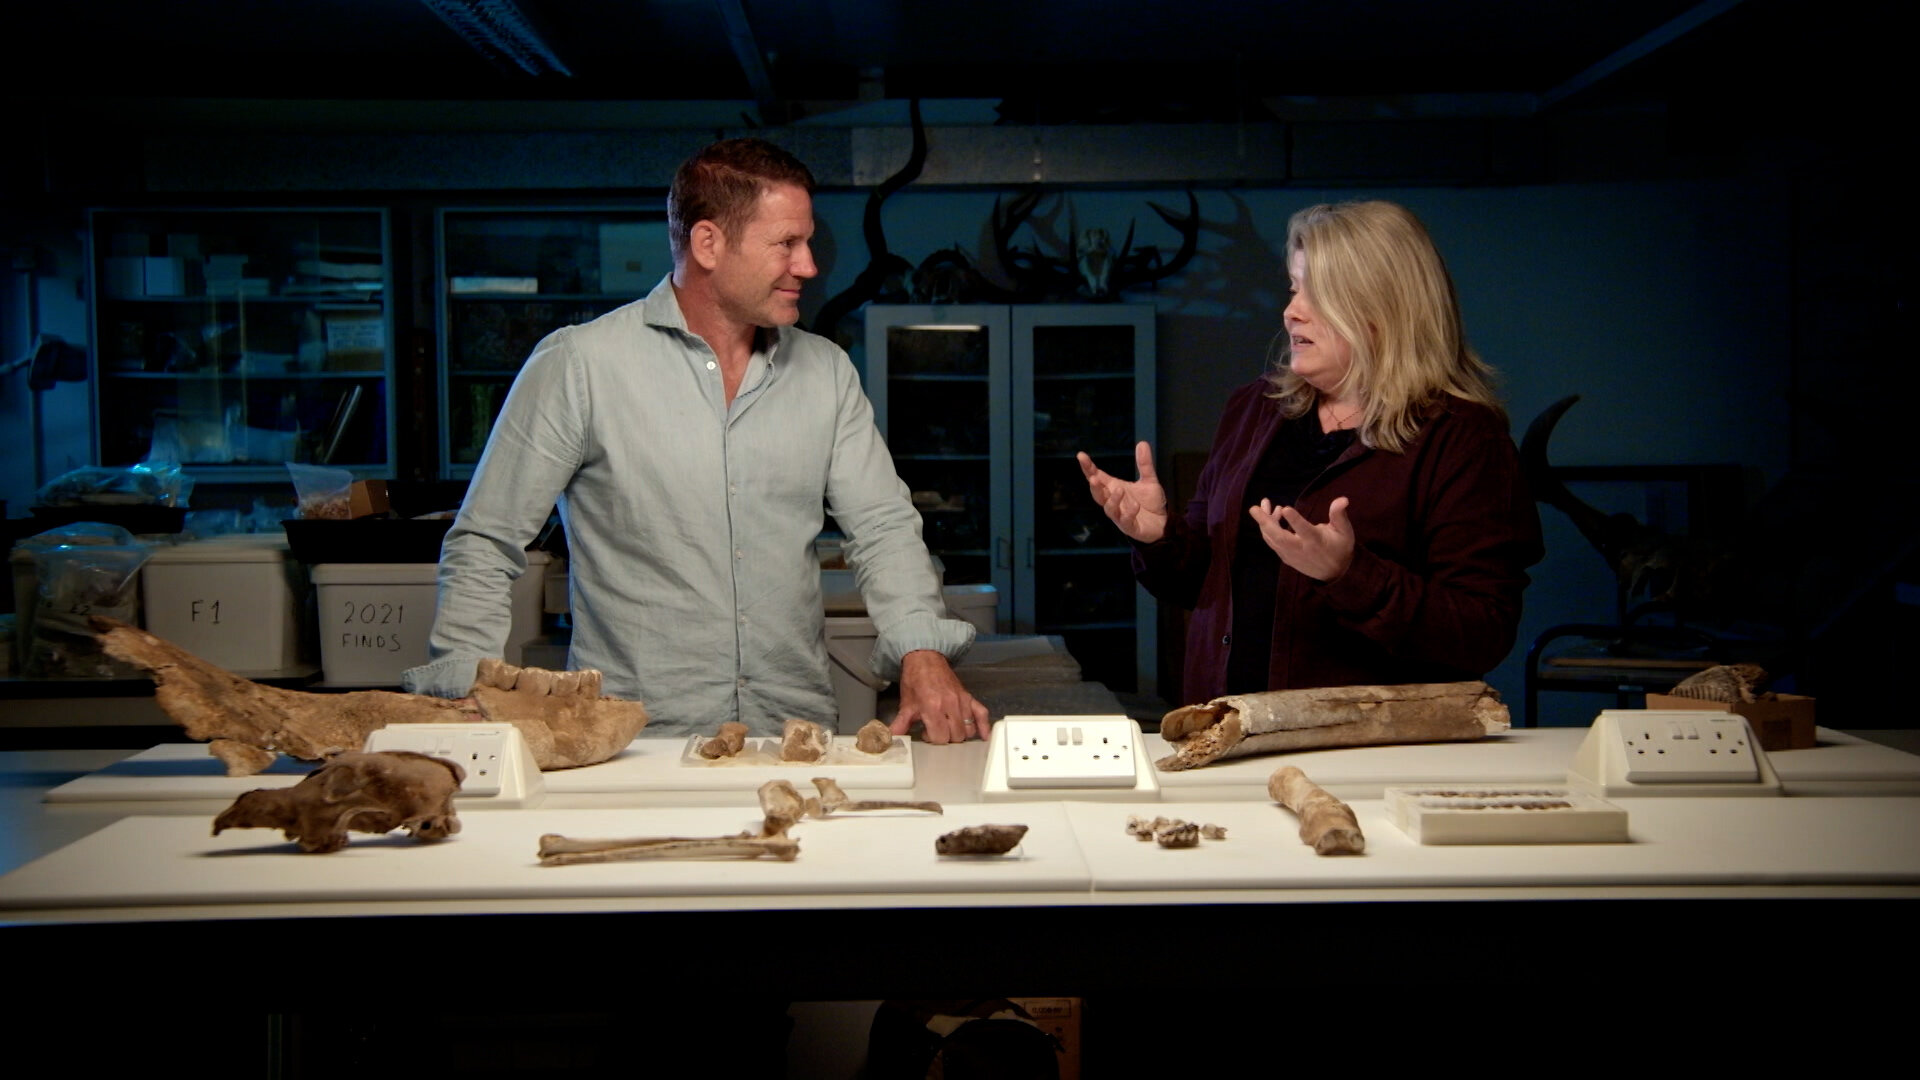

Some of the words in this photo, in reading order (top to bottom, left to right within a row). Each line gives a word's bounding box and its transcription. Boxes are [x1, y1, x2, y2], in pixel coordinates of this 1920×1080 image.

[191, 600, 221, 625] F1
[343, 602, 404, 625] 2021
[342, 633, 401, 652] FINDS
